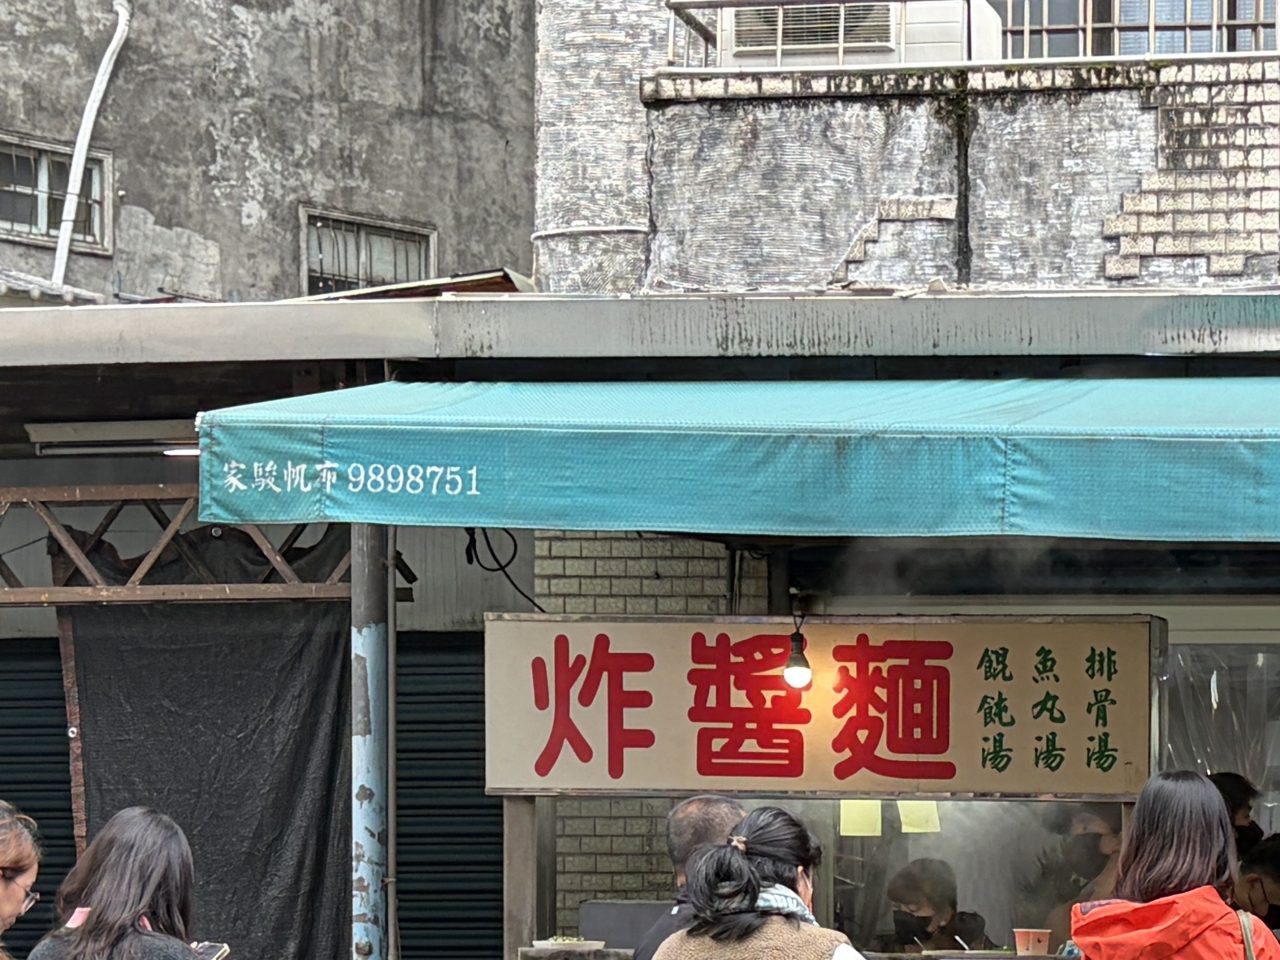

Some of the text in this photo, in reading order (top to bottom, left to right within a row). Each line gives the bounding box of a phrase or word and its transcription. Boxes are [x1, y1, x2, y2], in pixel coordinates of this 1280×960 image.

[223, 459, 481, 496] 家駿帆布 9898751
[531, 631, 957, 780] 炸醬麵
[976, 646, 1016, 773] 餛飩湯
[1031, 645, 1067, 773] 魚丸湯
[1085, 646, 1120, 773] 排骨湯
